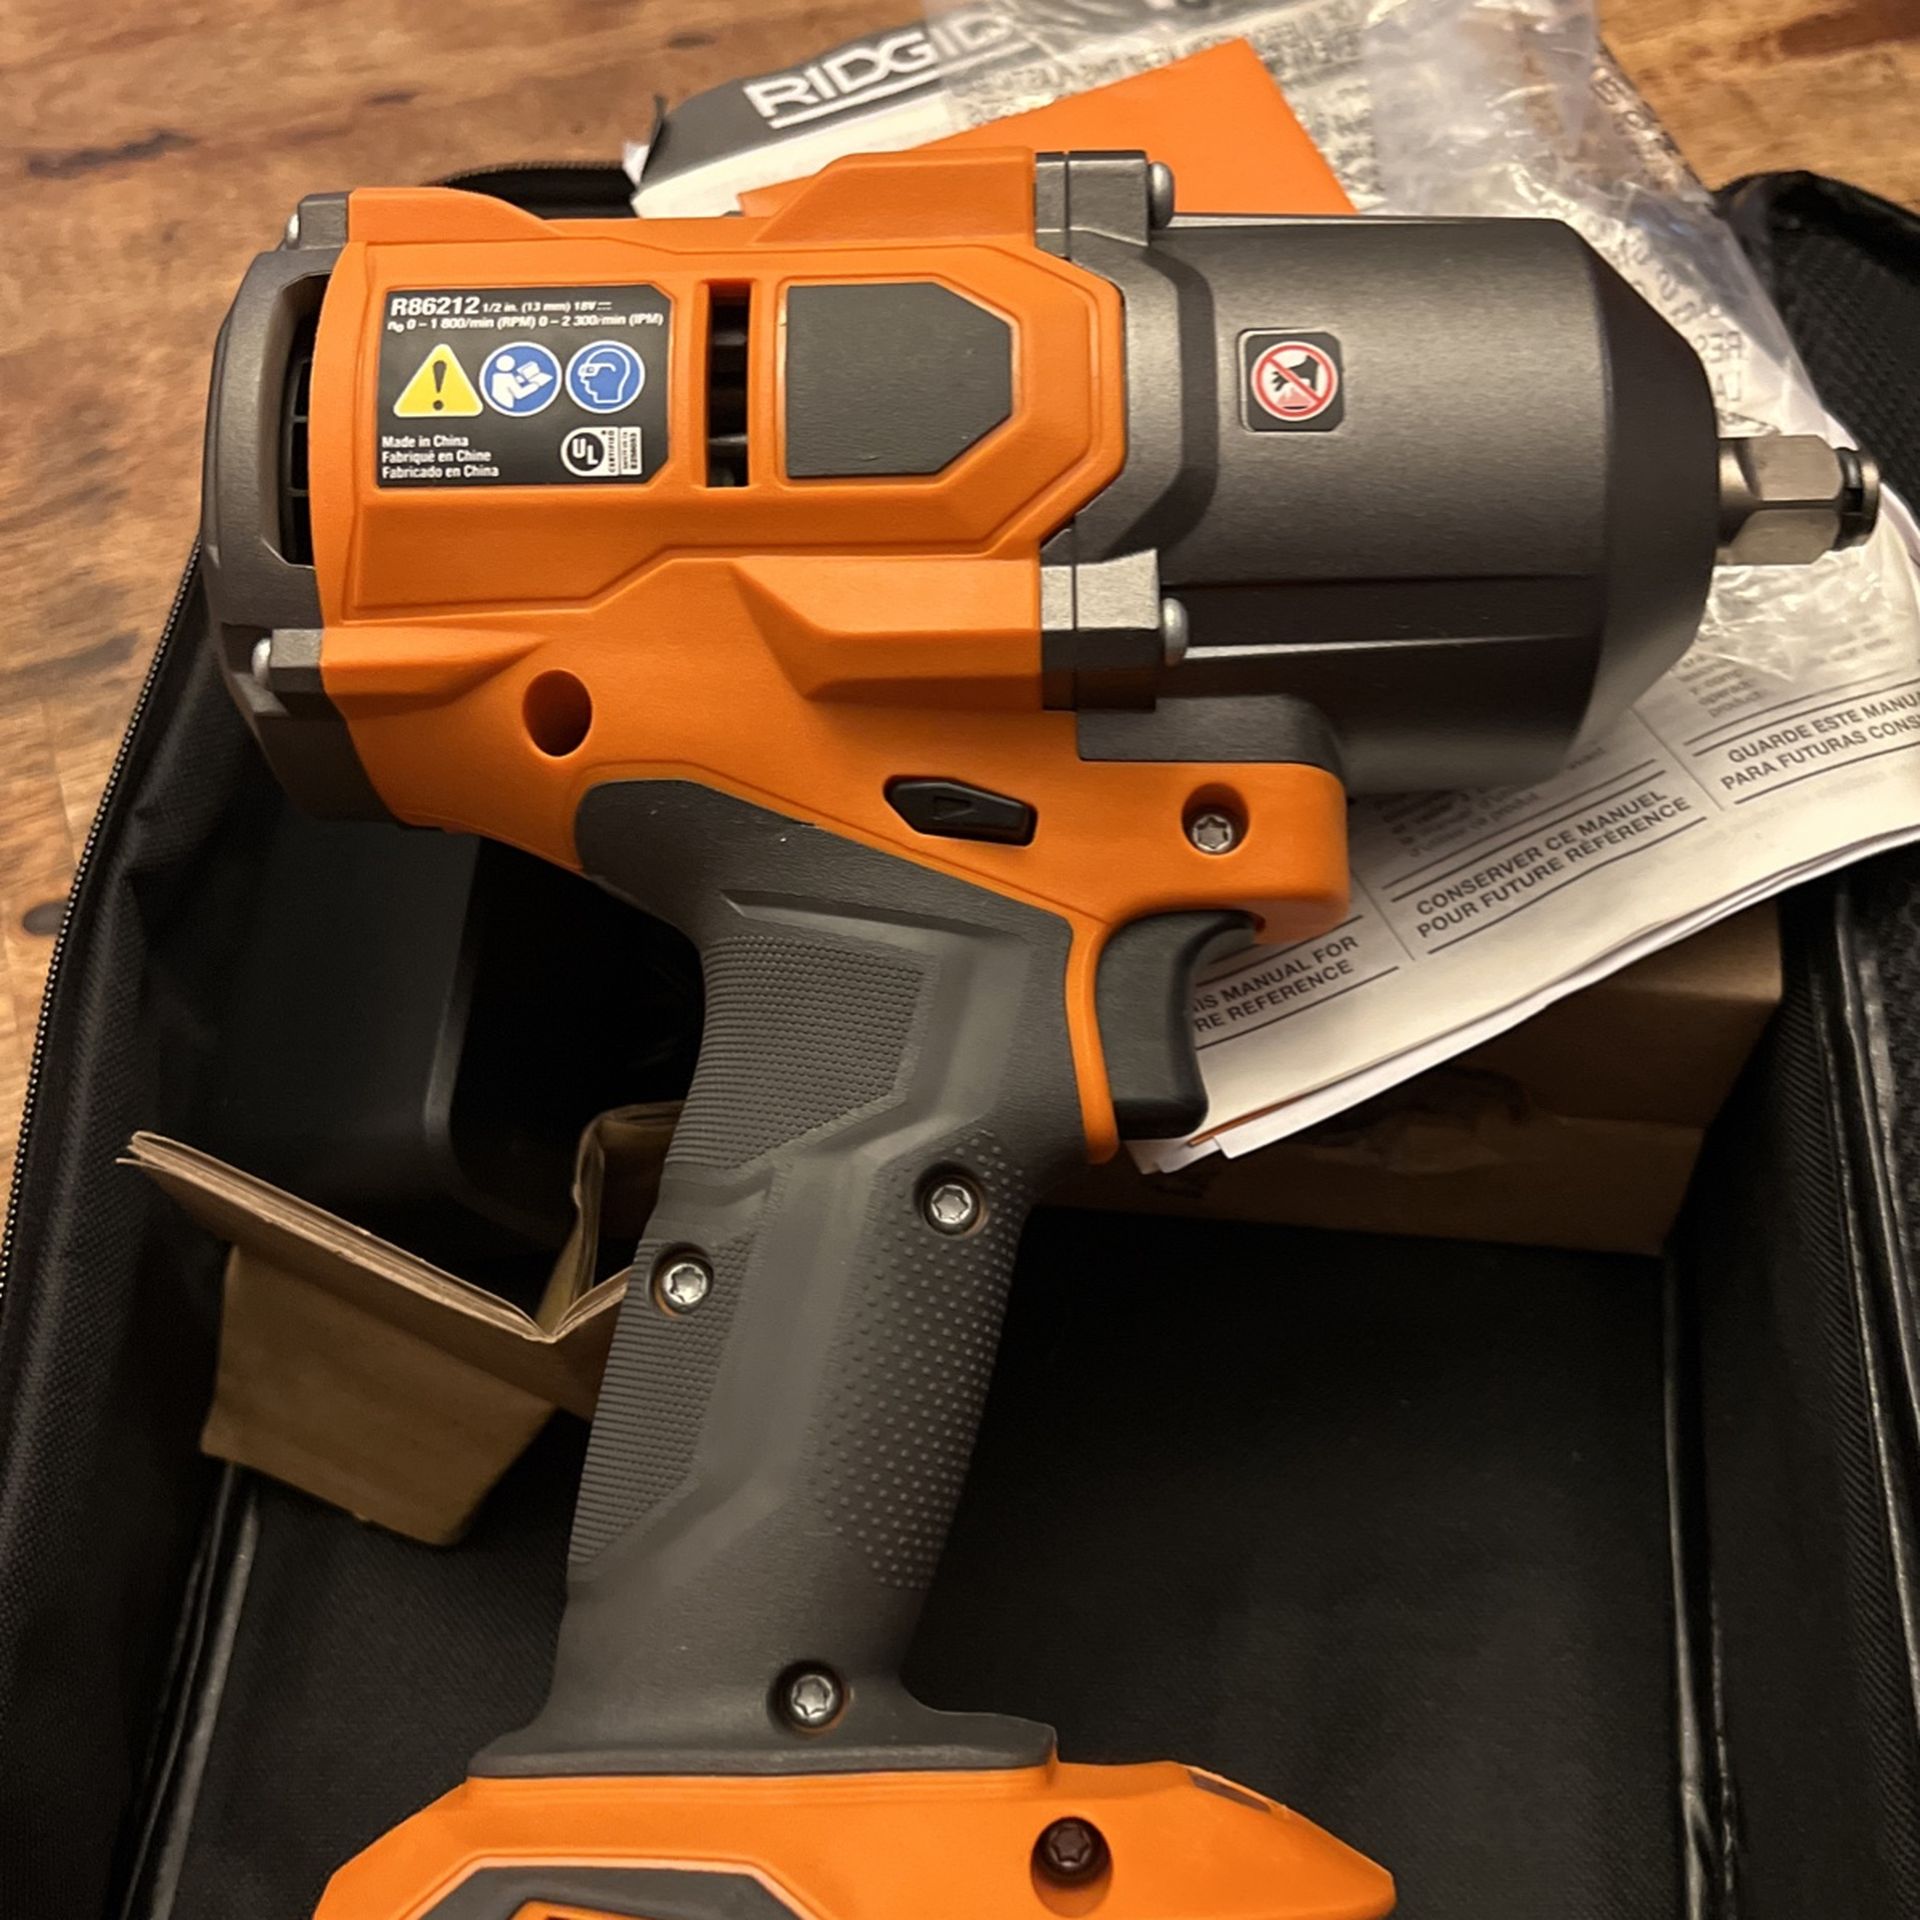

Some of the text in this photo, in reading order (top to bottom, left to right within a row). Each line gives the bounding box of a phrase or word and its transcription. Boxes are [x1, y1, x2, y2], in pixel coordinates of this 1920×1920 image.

[743, 12, 1013, 117] RIDGID
[391, 296, 480, 316] R86212
[483, 303, 501, 313] 1/2
[521, 302, 541, 313] (13
[497, 315, 536, 330] (RPM)
[628, 312, 664, 327] (IPM)
[382, 434, 469, 448] Made in China
[382, 449, 492, 465] Fabriqué en Chine
[382, 464, 499, 479] Fabricado en China
[1721, 714, 1920, 791] PARA FUTURAS CONS
[1727, 692, 1920, 764] GUARDE ESTE MANU
[1416, 846, 1545, 915] CONSERVER
[1545, 830, 1578, 852] CE
[1576, 789, 1669, 836] MANUEL
[1416, 901, 1480, 938] POUR
[1480, 856, 1565, 909] FUTURE
[1219, 958, 1311, 1002] MANUAL
[1312, 935, 1360, 964] FOR
[1227, 959, 1355, 1021] REFERENCE
